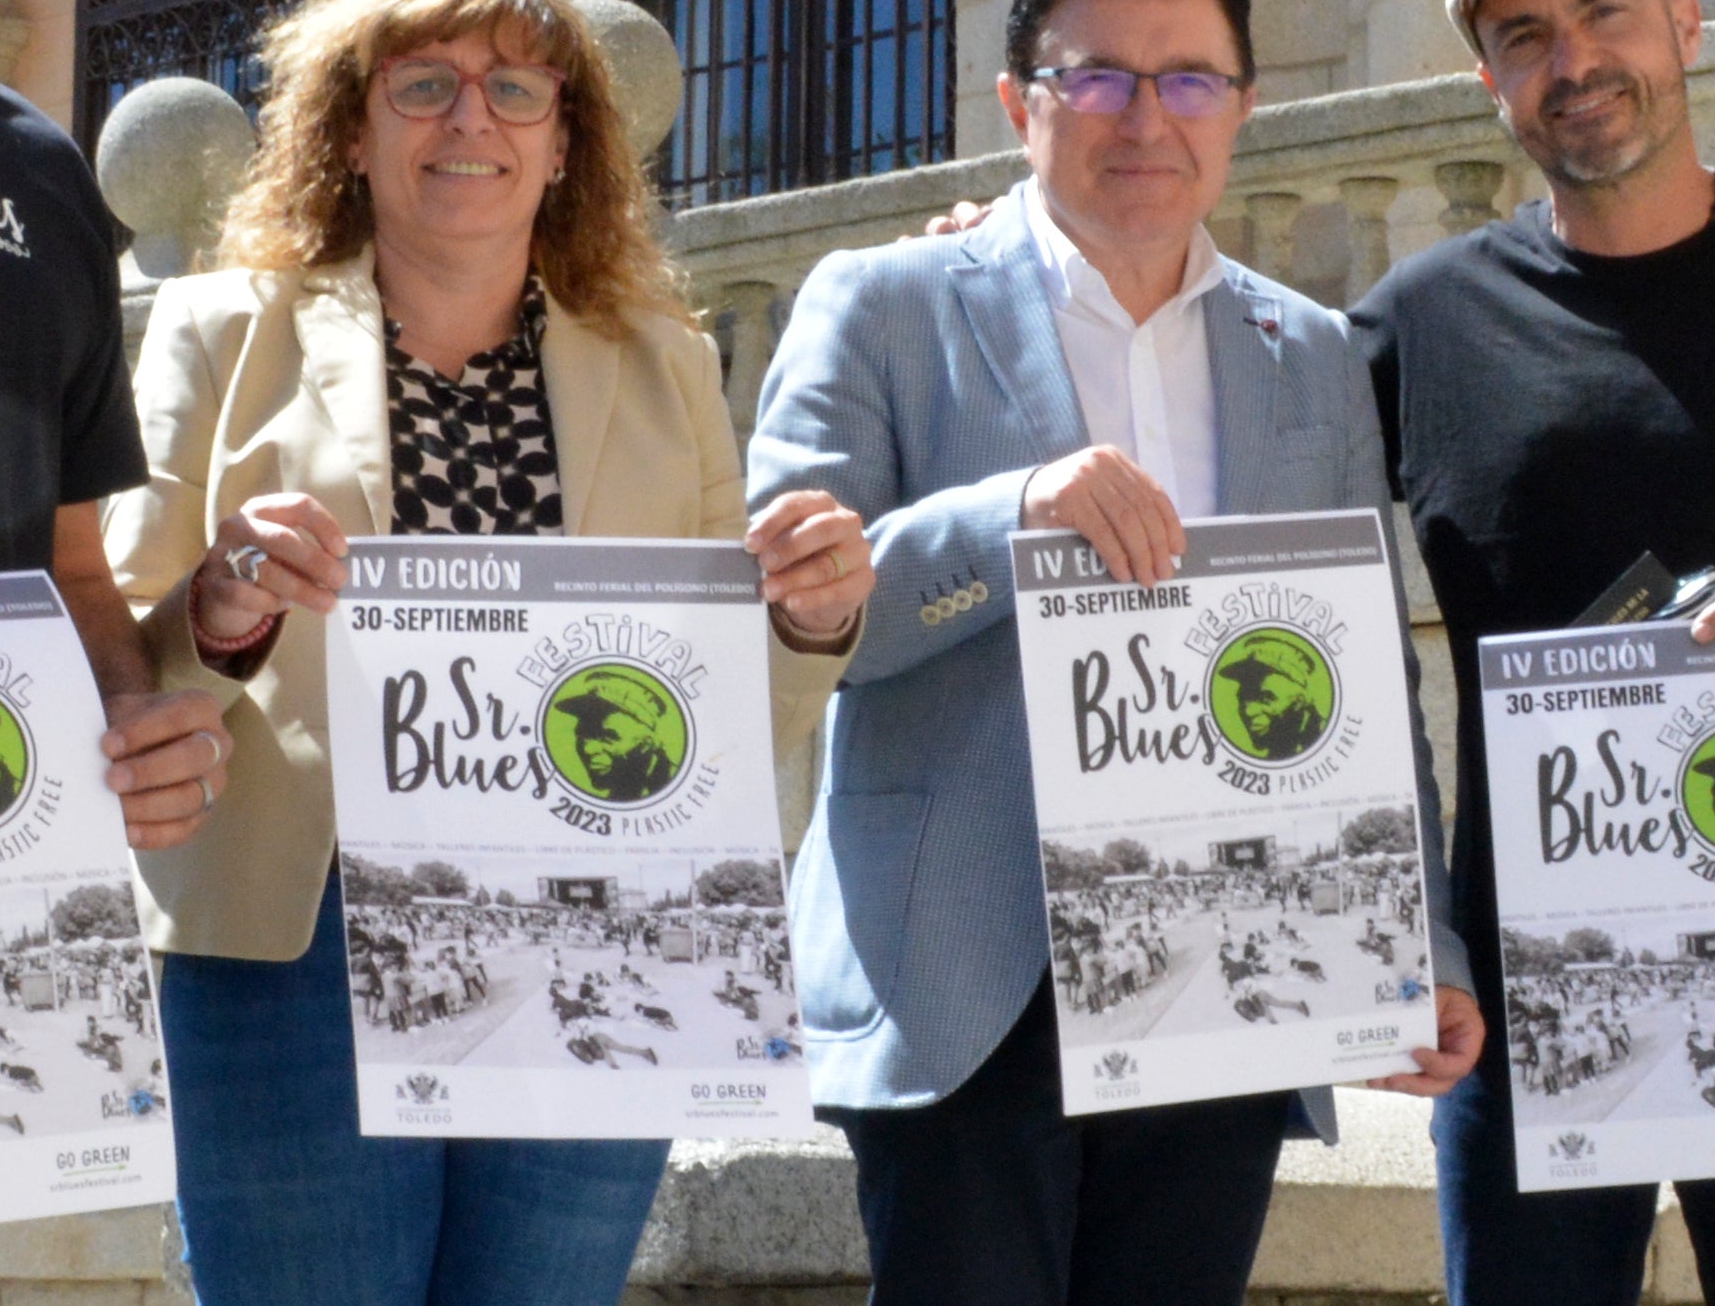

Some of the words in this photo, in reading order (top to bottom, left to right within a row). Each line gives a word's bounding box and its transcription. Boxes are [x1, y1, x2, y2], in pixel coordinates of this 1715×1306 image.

[352, 558, 385, 589] IV
[399, 553, 522, 592] EDICIÓN
[1033, 548, 1064, 579] IV
[352, 605, 529, 633] 30-SEPTIEMBRE
[1040, 584, 1193, 619] 30-SEPTIEMBRE
[1126, 632, 1201, 714] Sr.
[1501, 650, 1533, 680] IV
[1545, 638, 1657, 678] EDICIÓN
[449, 655, 532, 742] Sr.
[1071, 649, 1223, 774] Blues
[1506, 682, 1666, 716] 30-SEPTIEMBRE
[382, 669, 554, 800] Blues
[1216, 758, 1271, 796] 2023
[1277, 763, 1342, 794] PLASTIC
[1333, 714, 1363, 765] FREE
[1597, 728, 1672, 808] Sr.
[34, 774, 63, 826] FREE
[549, 796, 612, 836] 2023
[621, 803, 692, 838] PLASTIC
[686, 761, 720, 809] FREE
[1537, 745, 1693, 864] Blues
[1336, 1030, 1354, 1046] GO
[1358, 1026, 1400, 1043] GREEN
[690, 1083, 711, 1099] GO
[717, 1084, 767, 1099] GREEN
[397, 1112, 453, 1124] TOLEDO
[56, 1152, 76, 1170] GO
[81, 1145, 130, 1167] GREEN
